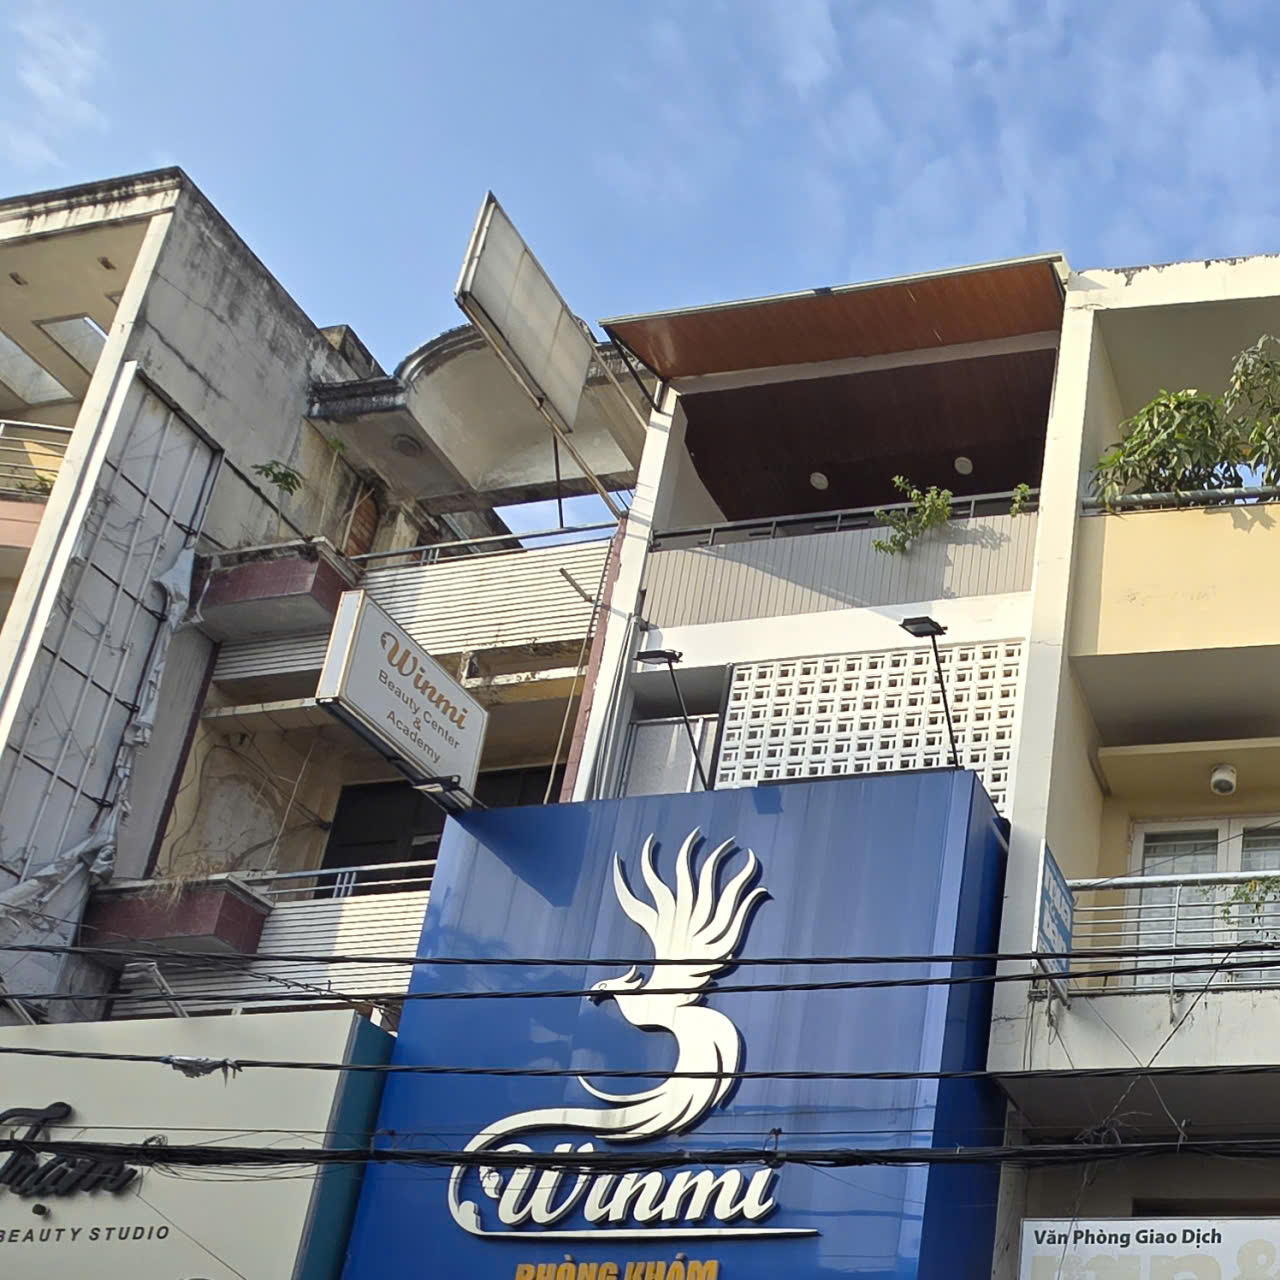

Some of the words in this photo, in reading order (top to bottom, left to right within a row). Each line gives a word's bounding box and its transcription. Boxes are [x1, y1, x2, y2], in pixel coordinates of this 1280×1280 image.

[380, 631, 468, 729] Winmi
[379, 669, 420, 714] Beauty
[423, 710, 460, 749] Center
[413, 717, 422, 731] &
[387, 711, 440, 764] Academy
[479, 1142, 774, 1225] Winmi
[89, 1226, 169, 1241] STUDIO
[1034, 1229, 1068, 1245] Văn
[1073, 1229, 1131, 1249] Phòng
[1135, 1229, 1177, 1245] Giao
[1181, 1229, 1222, 1249] Dịch
